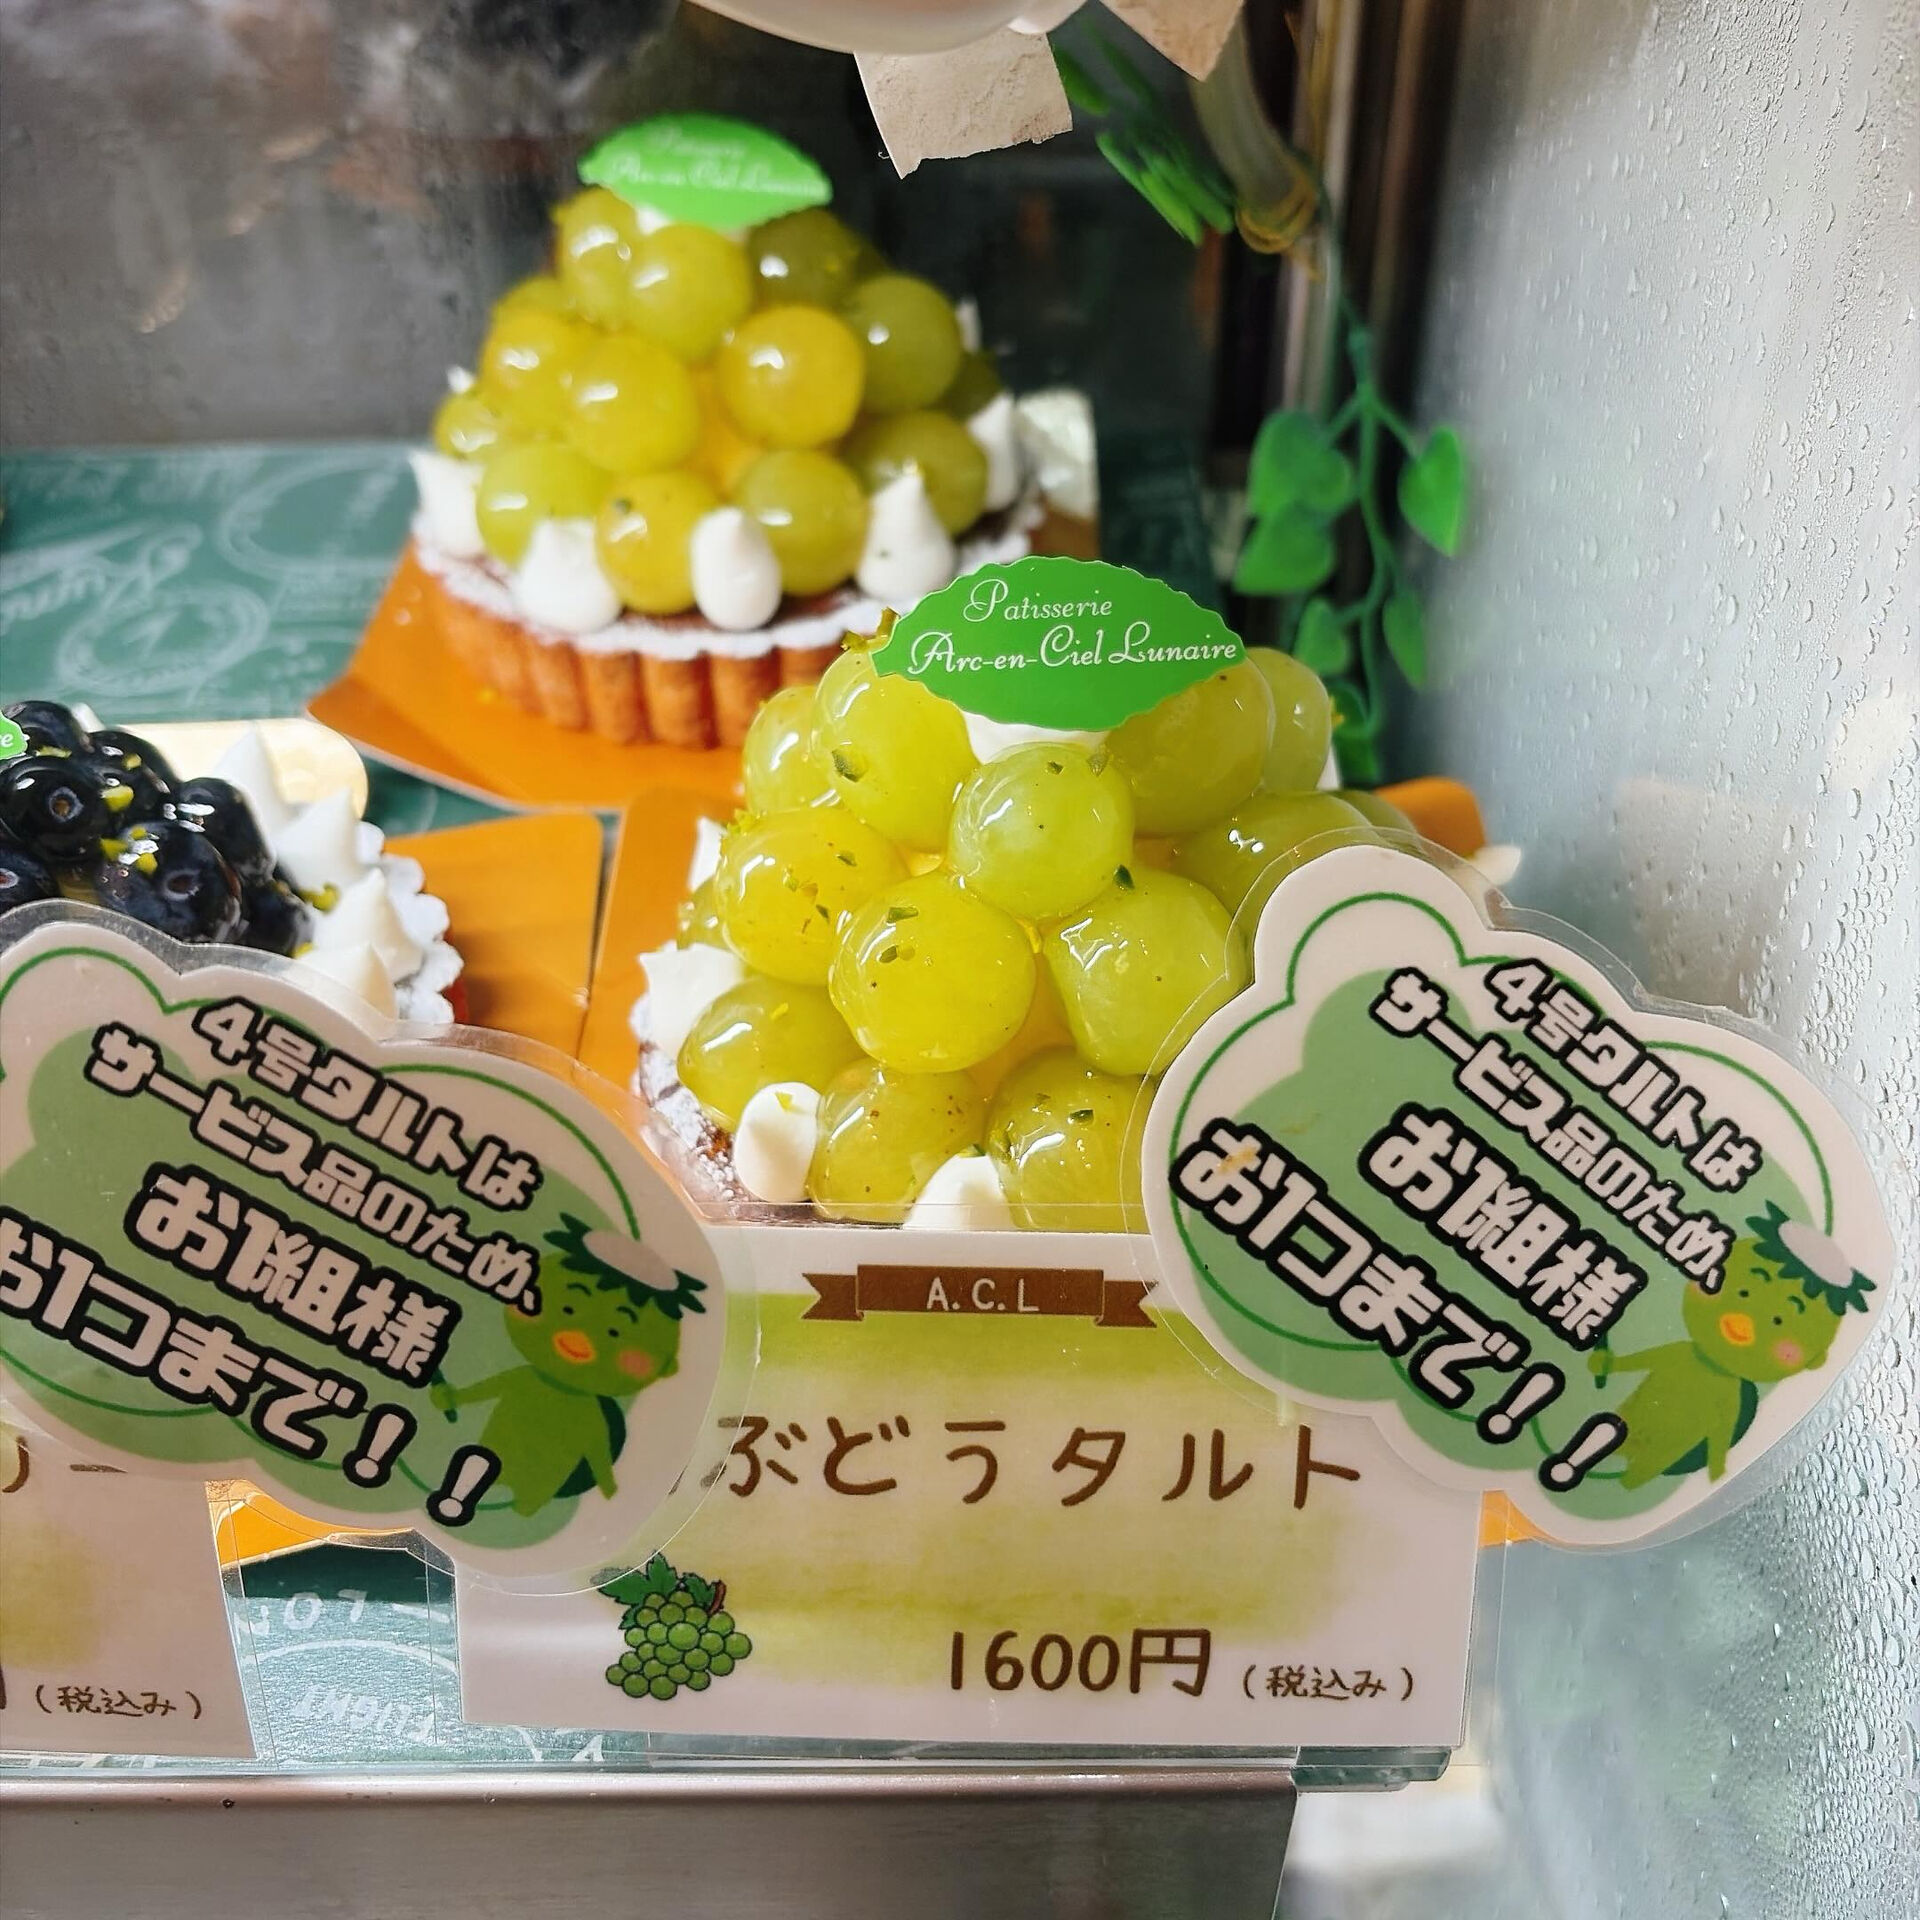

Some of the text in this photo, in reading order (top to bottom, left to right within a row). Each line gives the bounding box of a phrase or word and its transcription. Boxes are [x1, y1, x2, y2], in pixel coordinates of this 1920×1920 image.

[907, 621, 1237, 675] Arc-en-Ciel Lunaire
[963, 578, 1112, 622] Patisserie
[193, 995, 544, 1211] 4号タルトは
[1484, 958, 1764, 1196] 4号タルトは
[124, 1161, 463, 1388] お1組様
[925, 1275, 1042, 1313] A.C.L
[1357, 1101, 1648, 1350] お1組様
[949, 1627, 1212, 1698] 1600円
